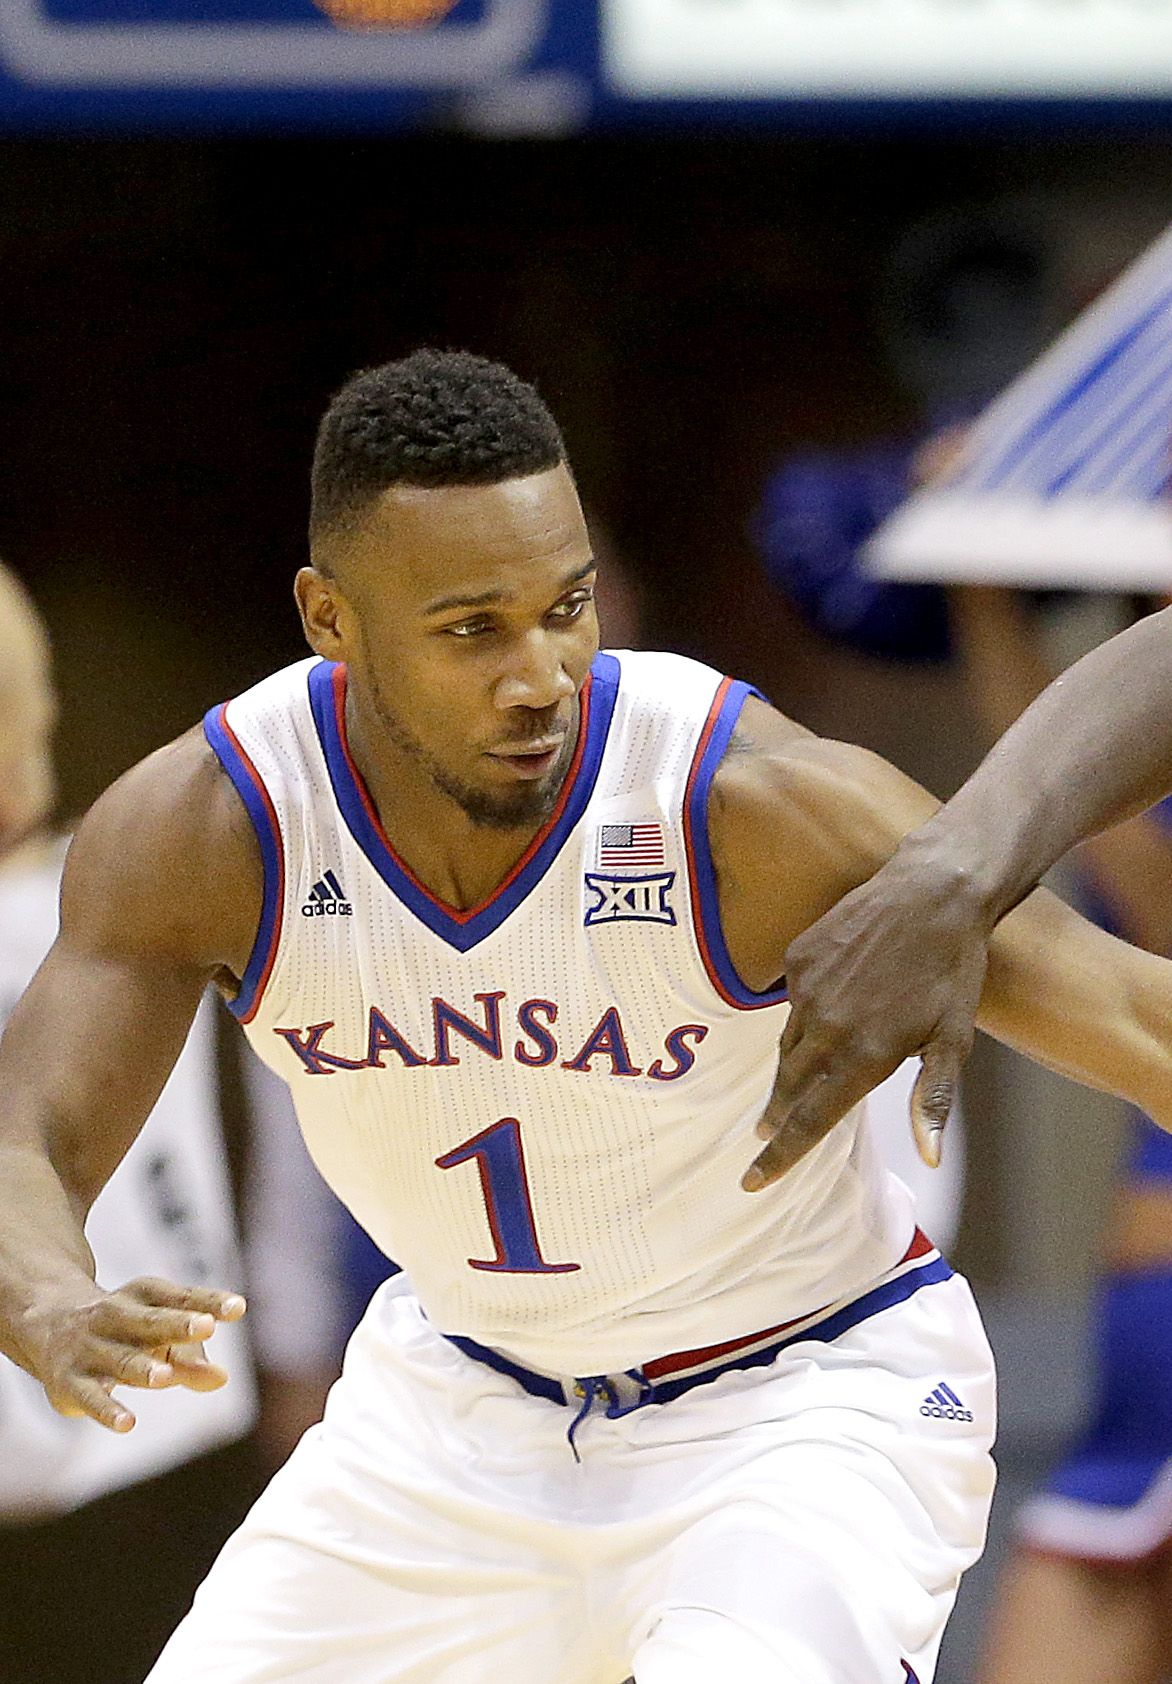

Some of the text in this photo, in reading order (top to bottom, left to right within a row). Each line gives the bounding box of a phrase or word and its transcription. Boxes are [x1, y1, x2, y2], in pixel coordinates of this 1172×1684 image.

[300, 899, 353, 918] adidas
[584, 872, 678, 926] XII
[274, 990, 709, 1082] KANSAS
[434, 1116, 582, 1274] 1
[919, 1404, 974, 1423] adidas
